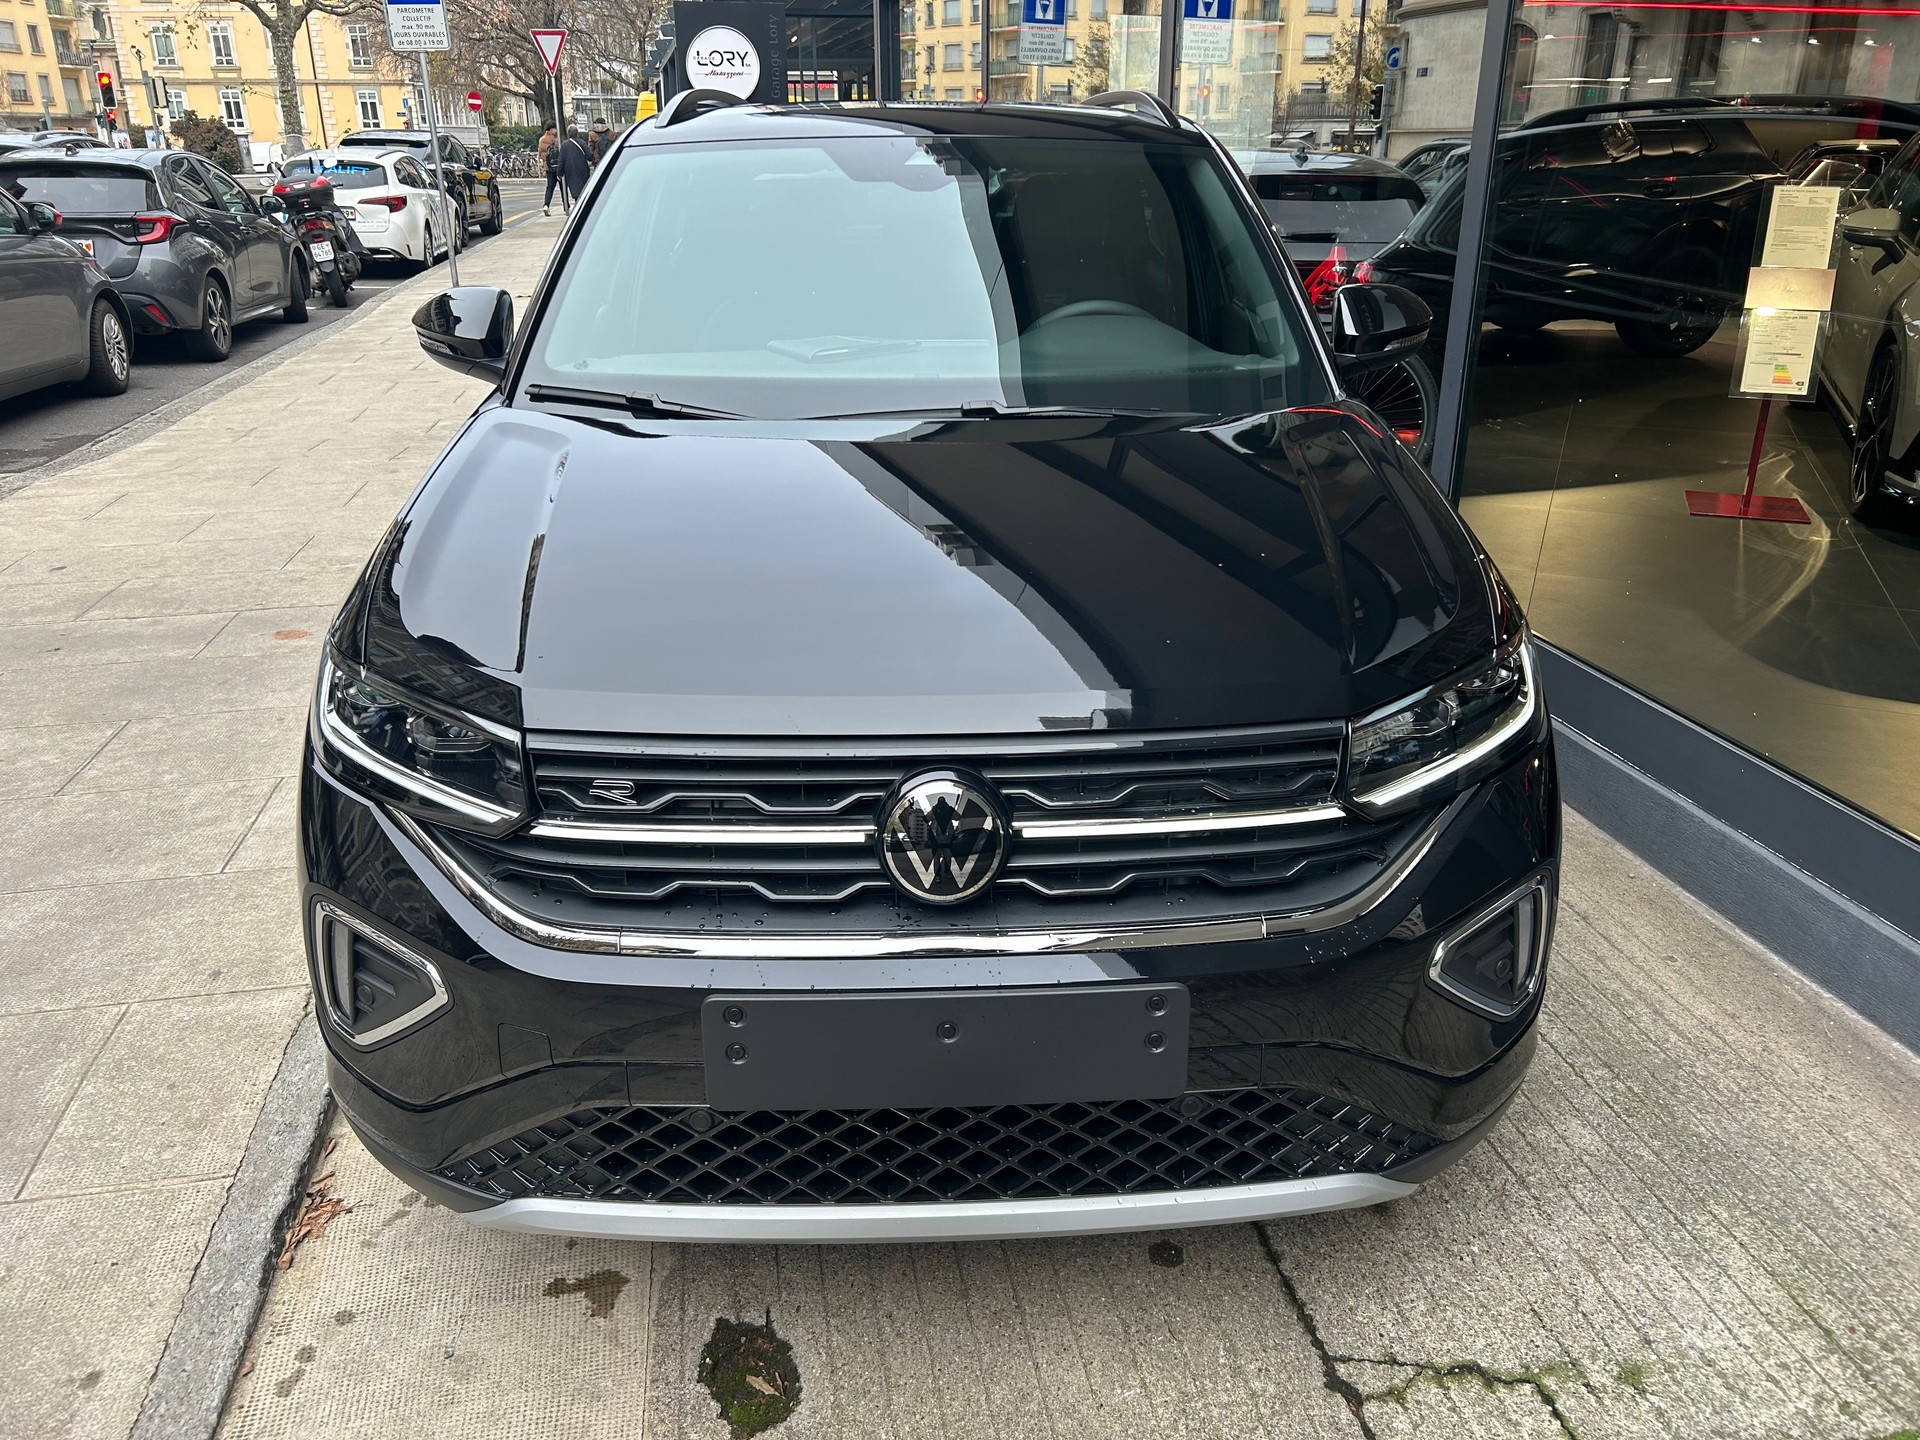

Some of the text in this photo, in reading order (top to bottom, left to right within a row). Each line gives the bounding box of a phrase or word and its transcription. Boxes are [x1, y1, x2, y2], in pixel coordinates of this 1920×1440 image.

[696, 50, 749, 67] LORY
[769, 15, 782, 98] Garage Lory
[589, 779, 637, 805] R
